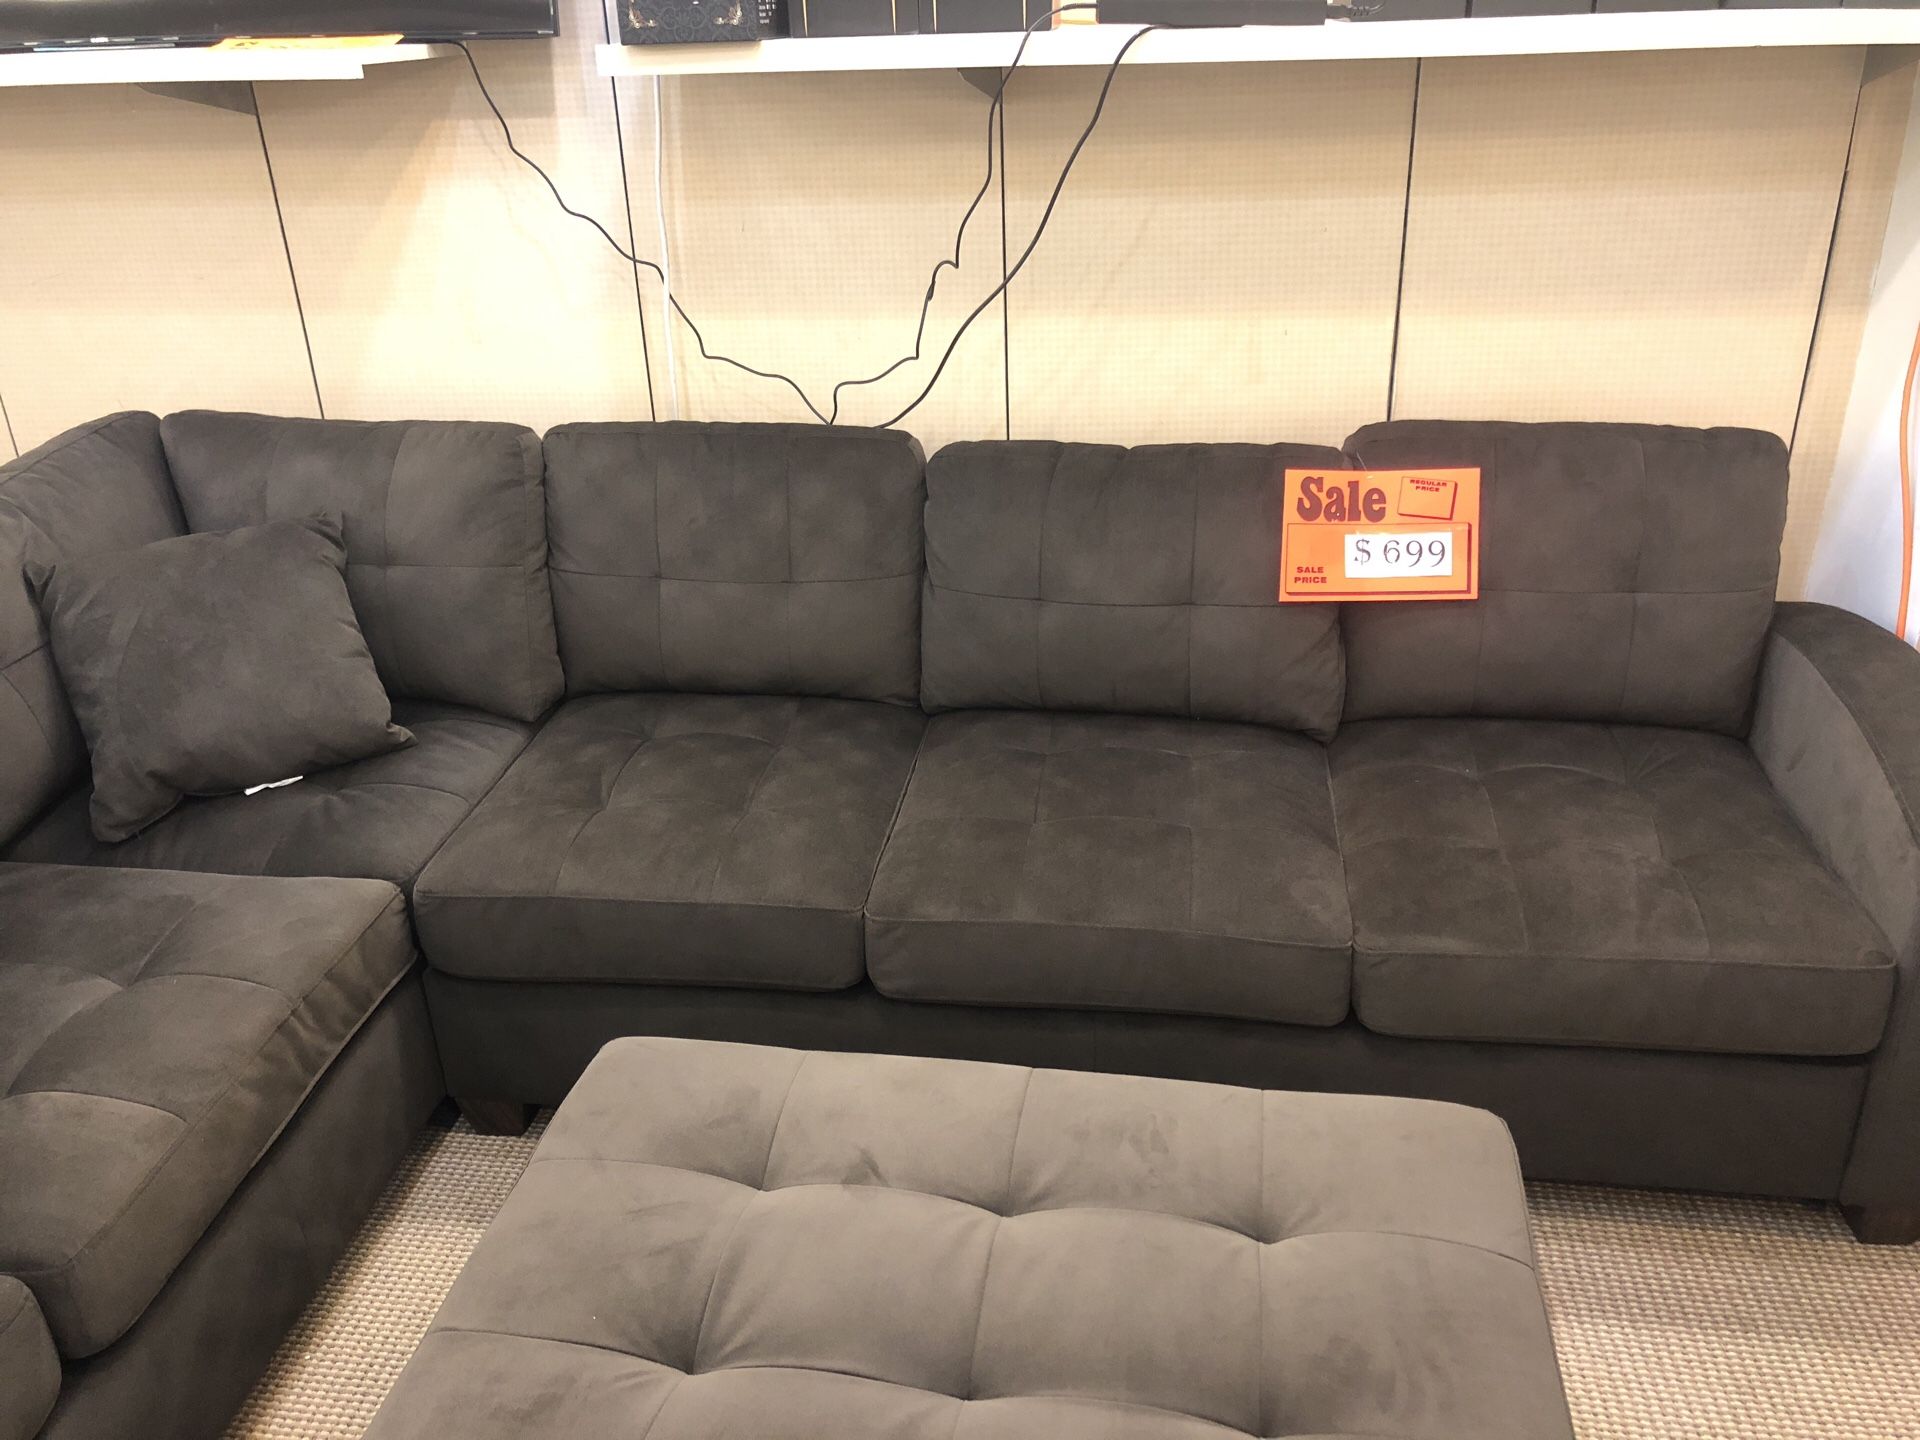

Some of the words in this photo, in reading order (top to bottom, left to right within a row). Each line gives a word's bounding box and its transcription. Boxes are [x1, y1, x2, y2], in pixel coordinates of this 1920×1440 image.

[1409, 479, 1447, 487] REGULAR
[1297, 476, 1386, 522] Sale
[1294, 576, 1327, 584] PRICE
